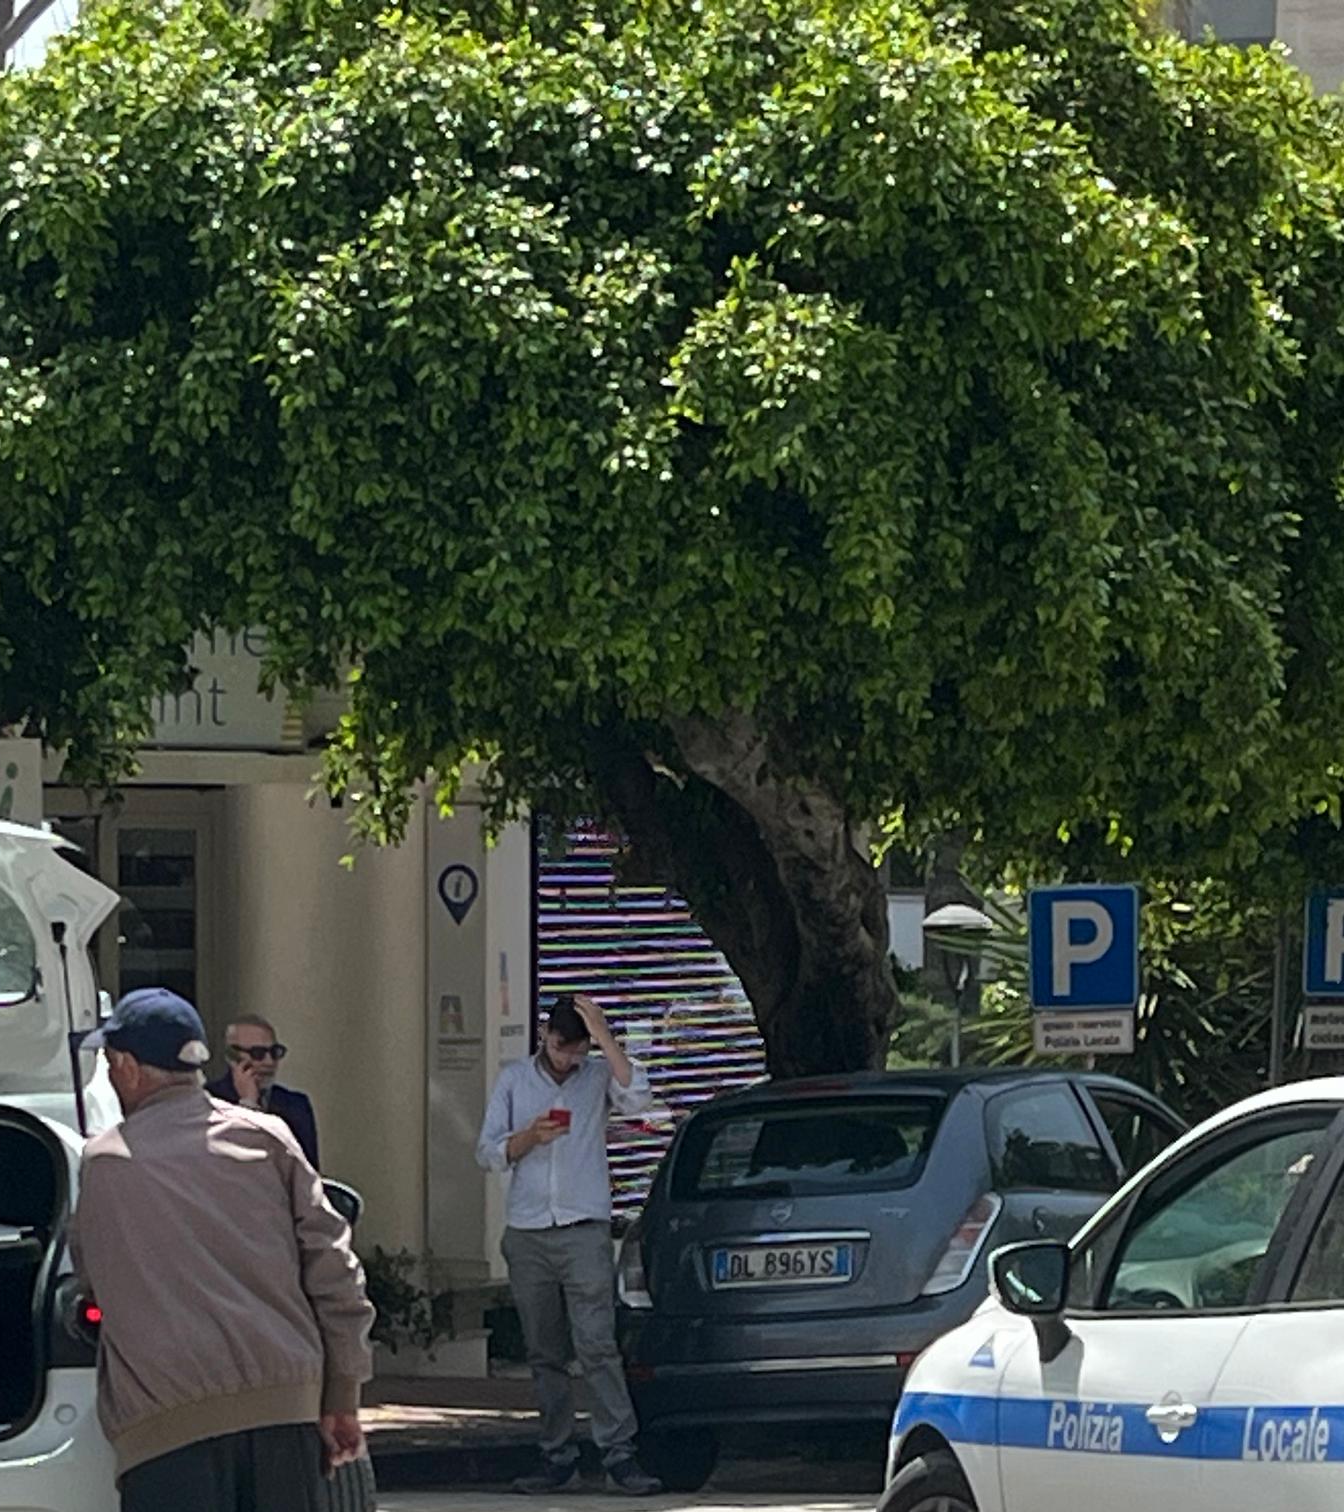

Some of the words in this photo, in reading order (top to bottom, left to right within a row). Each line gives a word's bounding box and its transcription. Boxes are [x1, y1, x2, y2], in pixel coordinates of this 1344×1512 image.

[1051, 900, 1114, 997] P
[730, 1254, 755, 1277] DL
[764, 1250, 835, 1276] 896YS
[1046, 1402, 1124, 1451] Polizia
[1242, 1407, 1330, 1461] Locale
